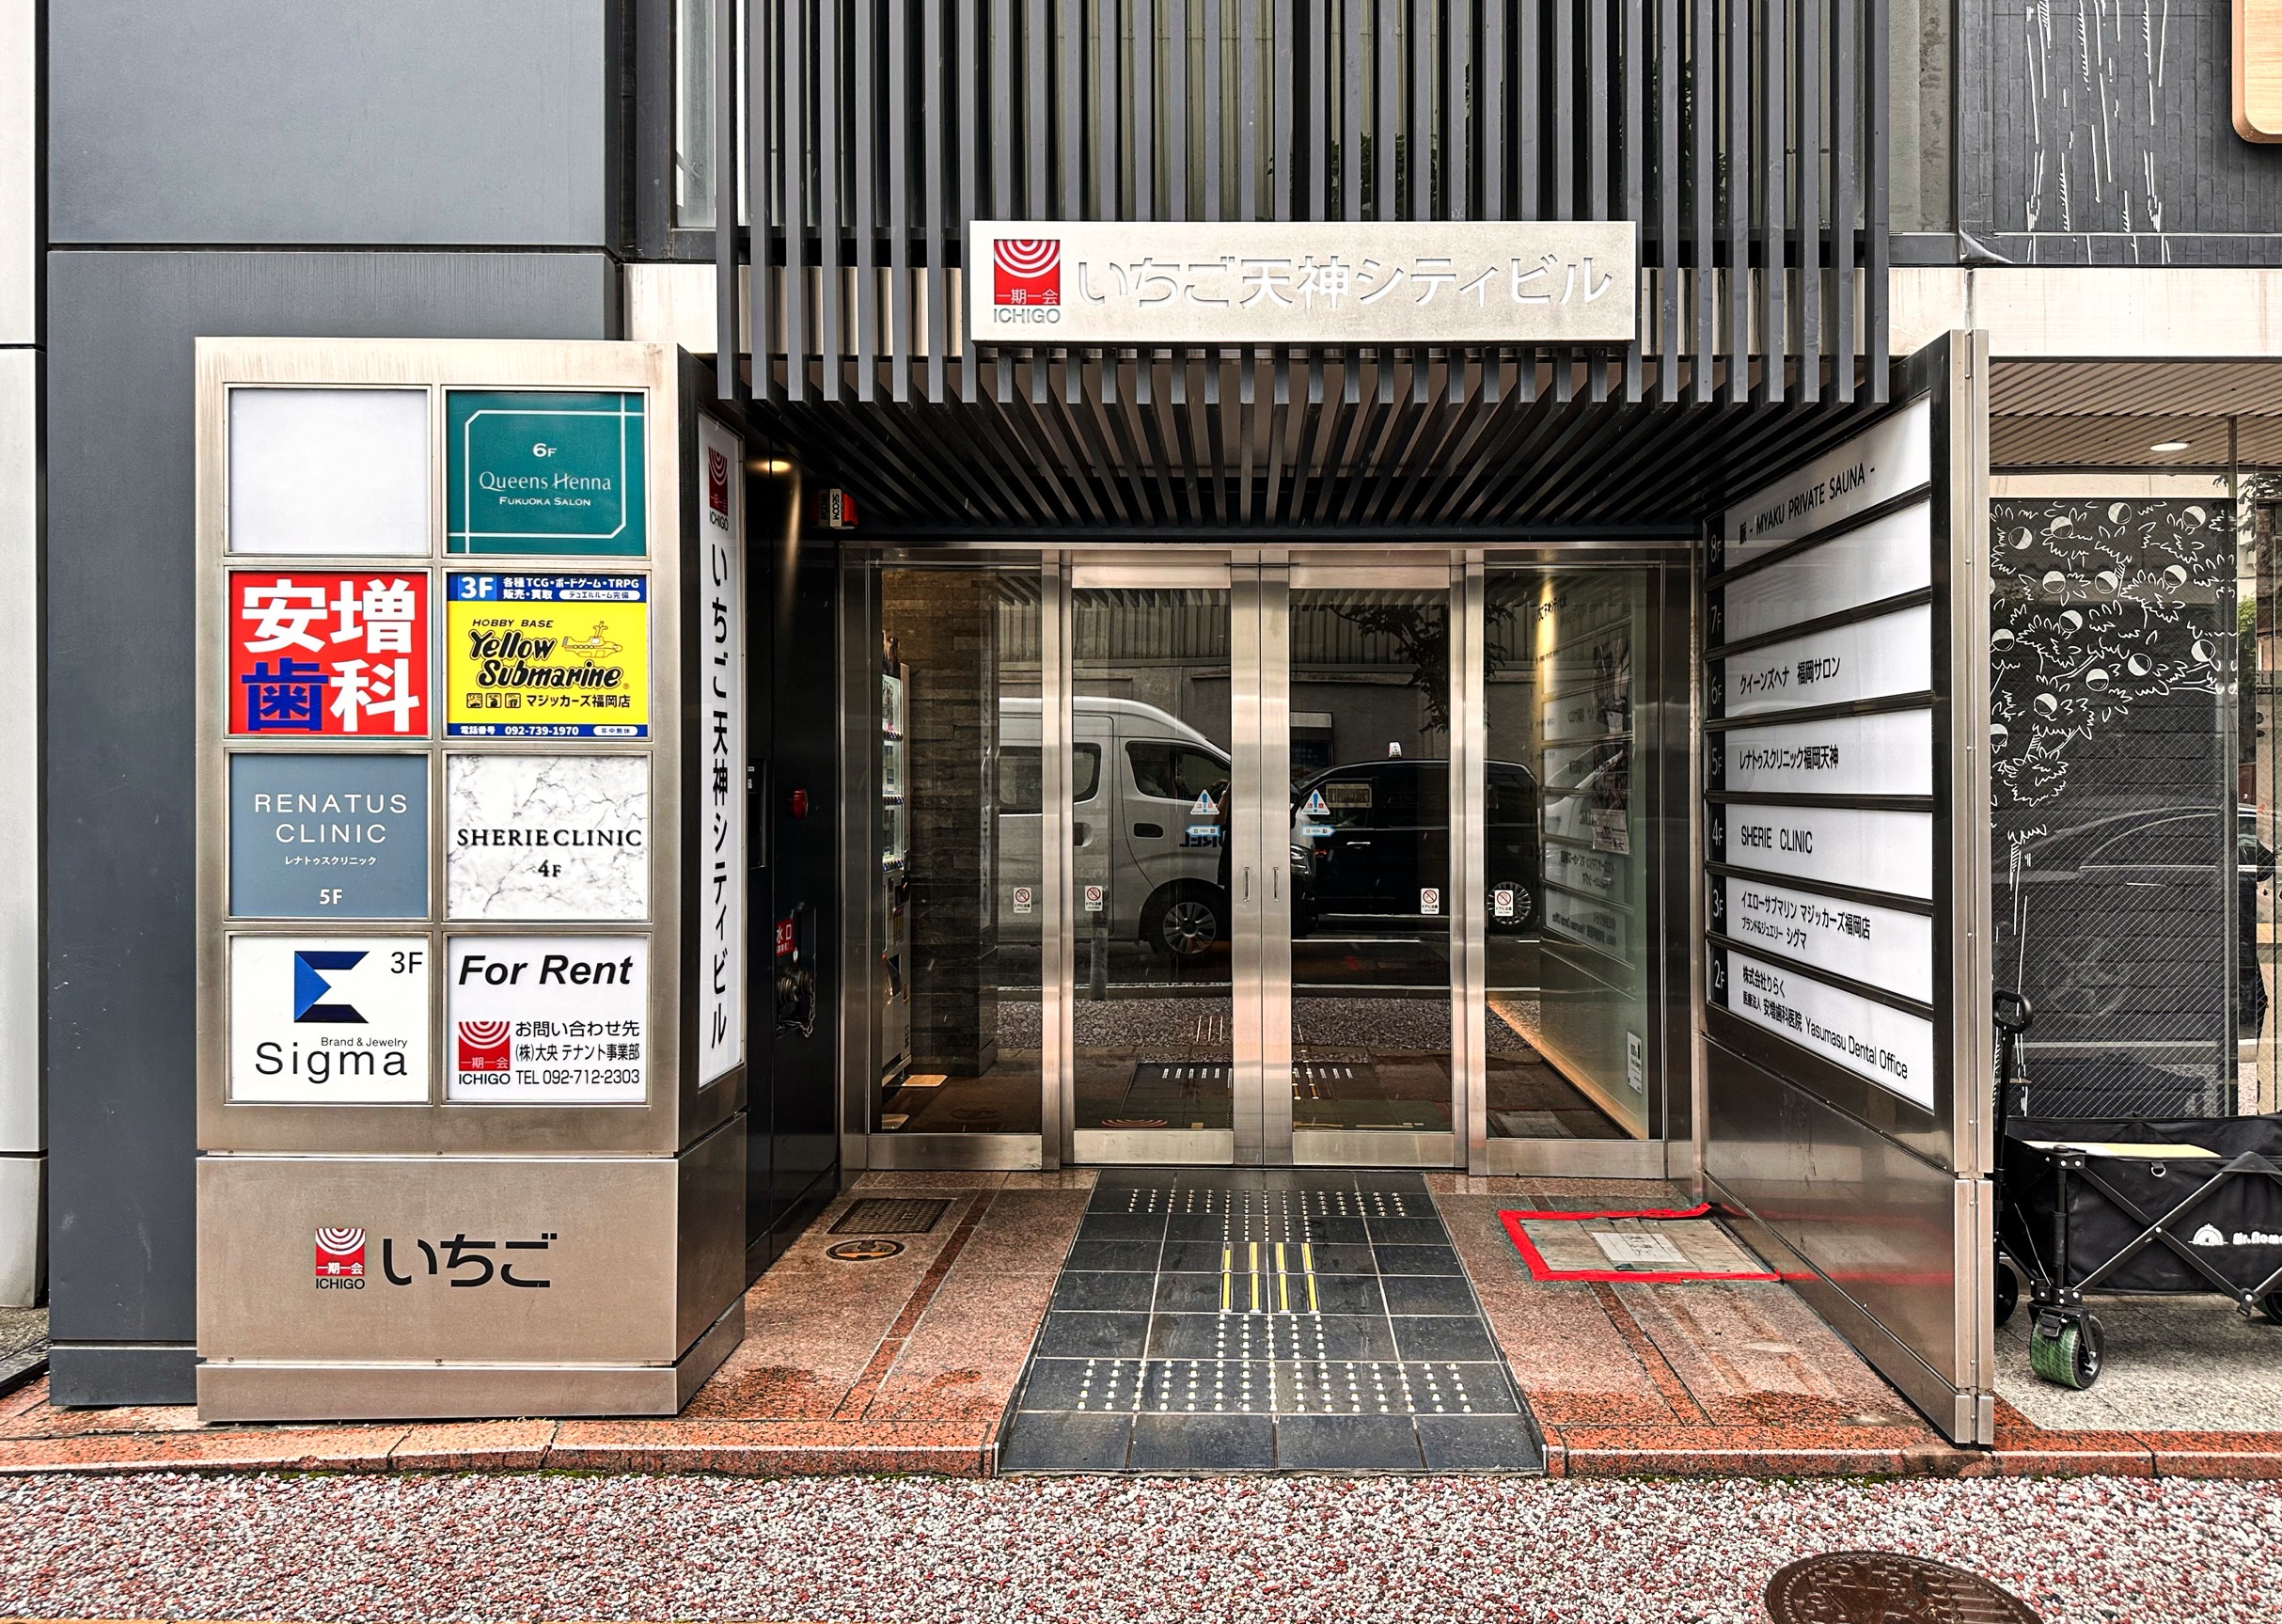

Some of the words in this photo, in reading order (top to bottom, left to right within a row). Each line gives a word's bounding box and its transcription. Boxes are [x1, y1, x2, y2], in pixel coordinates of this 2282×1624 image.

[1078, 254, 1613, 309] いちご天神シティビル
[996, 288, 1059, 305] 一期一会
[994, 307, 1061, 323] ICHIGO
[532, 442, 558, 458] 6F
[479, 471, 548, 492] Queens
[552, 472, 612, 490] Henna
[499, 497, 551, 506] FUKUOKA
[554, 497, 591, 507] SALON
[1755, 506, 1785, 535] MYAKU
[1788, 482, 1825, 520] PRIVATE
[1829, 463, 1865, 500] SAUNA
[709, 510, 730, 531] ICHIGO
[1710, 534, 1722, 563] 8F
[461, 576, 495, 599] 3F
[503, 589, 553, 600] 販売・買取
[242, 578, 416, 654] 安増
[472, 619, 515, 628] HOBBY
[521, 620, 554, 628] BASE
[1710, 606, 1722, 635] 7F
[469, 630, 557, 660] Yellow
[478, 659, 622, 688] Submarine
[1739, 666, 1790, 695] クイーンズヘナ
[1797, 657, 1840, 686] 福岡サロン
[241, 656, 420, 733] 歯科
[527, 694, 631, 709] マジッカーズ福岡店
[1711, 677, 1723, 705] 6F
[460, 725, 496, 735] 電話番号
[505, 725, 579, 736] 092-739-1970
[1711, 748, 1723, 776] 5F
[1739, 744, 1840, 770] レナトゥスクリニック福岡天神
[255, 794, 408, 813] RENATUS
[711, 544, 729, 1049] いちご天神シティビル
[275, 824, 386, 844] CLINIC
[457, 828, 549, 846] SHERIE
[553, 829, 642, 846] CLINIC
[1711, 818, 1723, 846] 4F
[1740, 826, 1772, 849] SHERIE
[1780, 828, 1814, 855] CLINIC
[285, 856, 377, 866] レナトゥスクリニック
[537, 859, 562, 878] 4F
[319, 889, 343, 905] 5F
[1712, 889, 1724, 919] 3F
[1741, 891, 1797, 920] イエローサブマリン
[1800, 904, 1871, 940] マジッカーズ福岡店
[1741, 916, 1784, 940] ブランド&ジュエリー
[1786, 927, 1807, 950] シグマ
[390, 952, 423, 974] 3F
[458, 955, 528, 985] For
[539, 954, 634, 985] Rent
[1714, 959, 1725, 989] 2F
[1742, 964, 1786, 998] 株式会社りらく
[515, 1020, 640, 1038] お問い合わせ先
[1763, 997, 1802, 1033] 安増歯科医院
[1805, 1016, 1847, 1050] Yasumasu
[1849, 1035, 1877, 1065] Dental
[1880, 1049, 1908, 1080] Office
[321, 1037, 354, 1047] Brand
[356, 1038, 364, 1047] &
[366, 1037, 408, 1049] Jewelry
[515, 1043, 559, 1062] (株)大央
[562, 1043, 640, 1062] テナント事業部
[255, 1041, 408, 1084] Sigma
[460, 1056, 510, 1069] 一期一会
[458, 1073, 511, 1085] ICHIGO
[515, 1070, 540, 1084] TEL
[543, 1069, 640, 1085] 092-712-2303
[316, 1261, 364, 1275] 一期一会
[383, 1233, 558, 1288] いちご
[315, 1278, 366, 1290] ICHIGO
